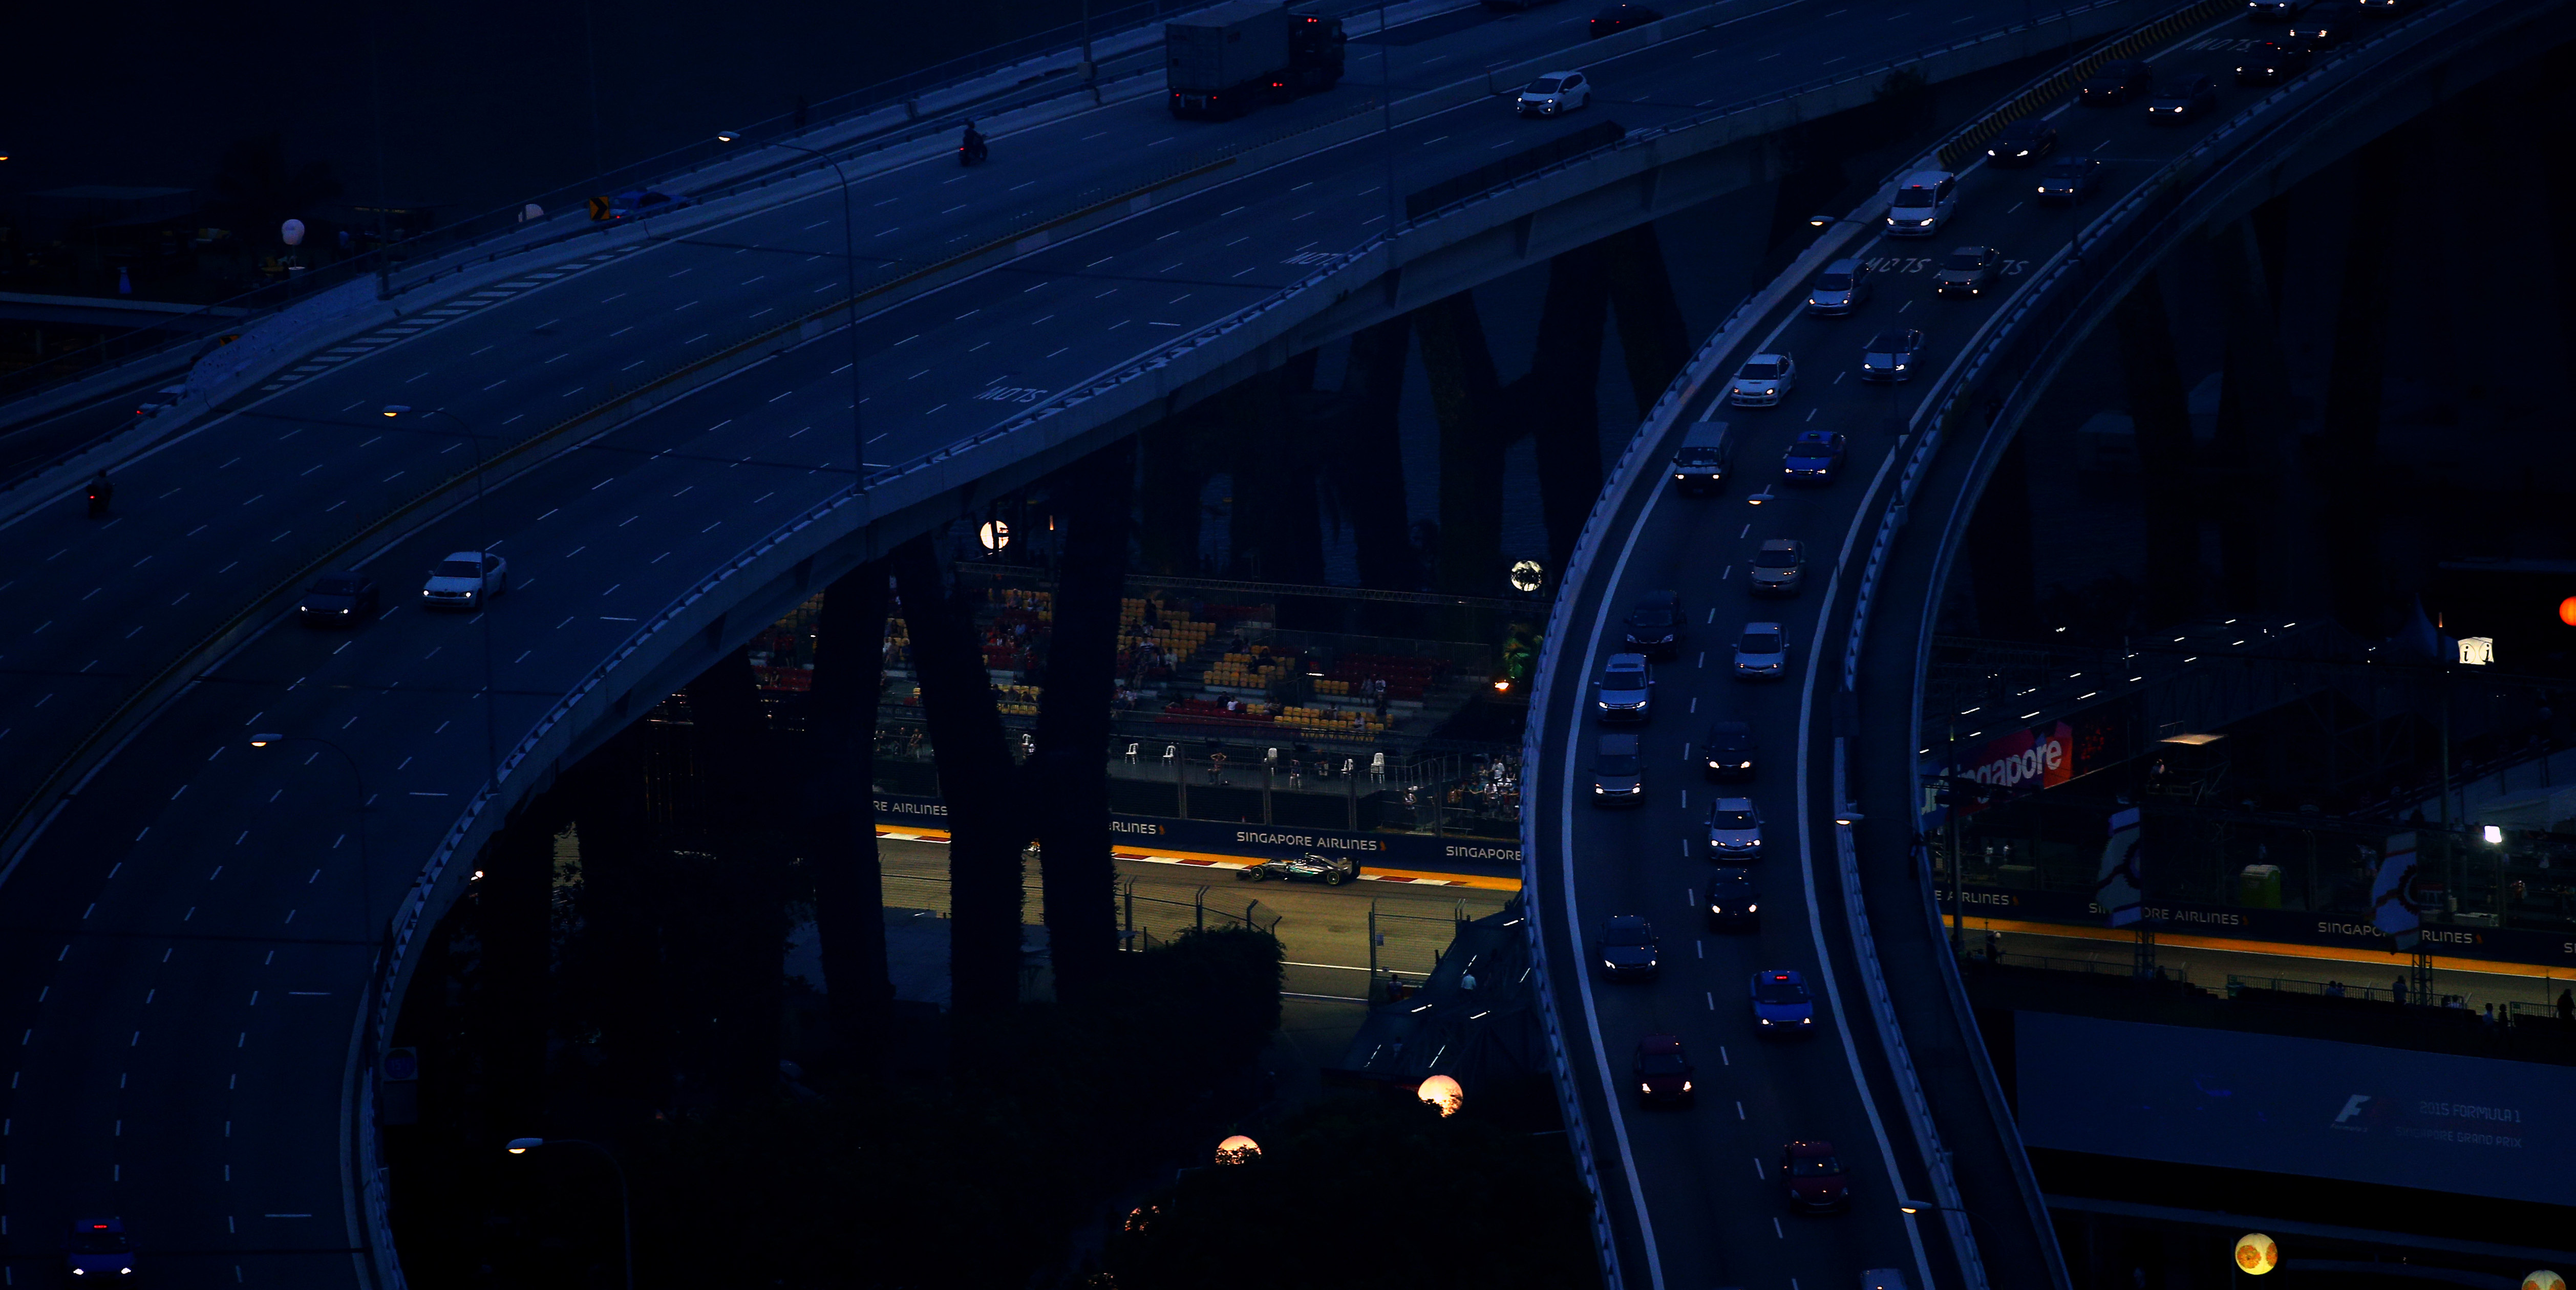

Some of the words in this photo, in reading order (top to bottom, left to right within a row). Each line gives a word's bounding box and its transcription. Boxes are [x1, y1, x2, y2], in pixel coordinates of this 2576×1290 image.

[892, 803, 948, 816] AIRLINES
[1237, 831, 1312, 846] SINGAPORE
[1317, 837, 1377, 851] AIRLINES
[1446, 846, 1521, 861] SINGAPORE
[2175, 910, 2239, 925] AIRLINES
[2420, 1101, 2450, 1116] 2015
[2453, 1104, 2511, 1122] FORMULA
[2457, 1132, 2493, 1146] GRAND
[2496, 1136, 2523, 1149] PRIX
